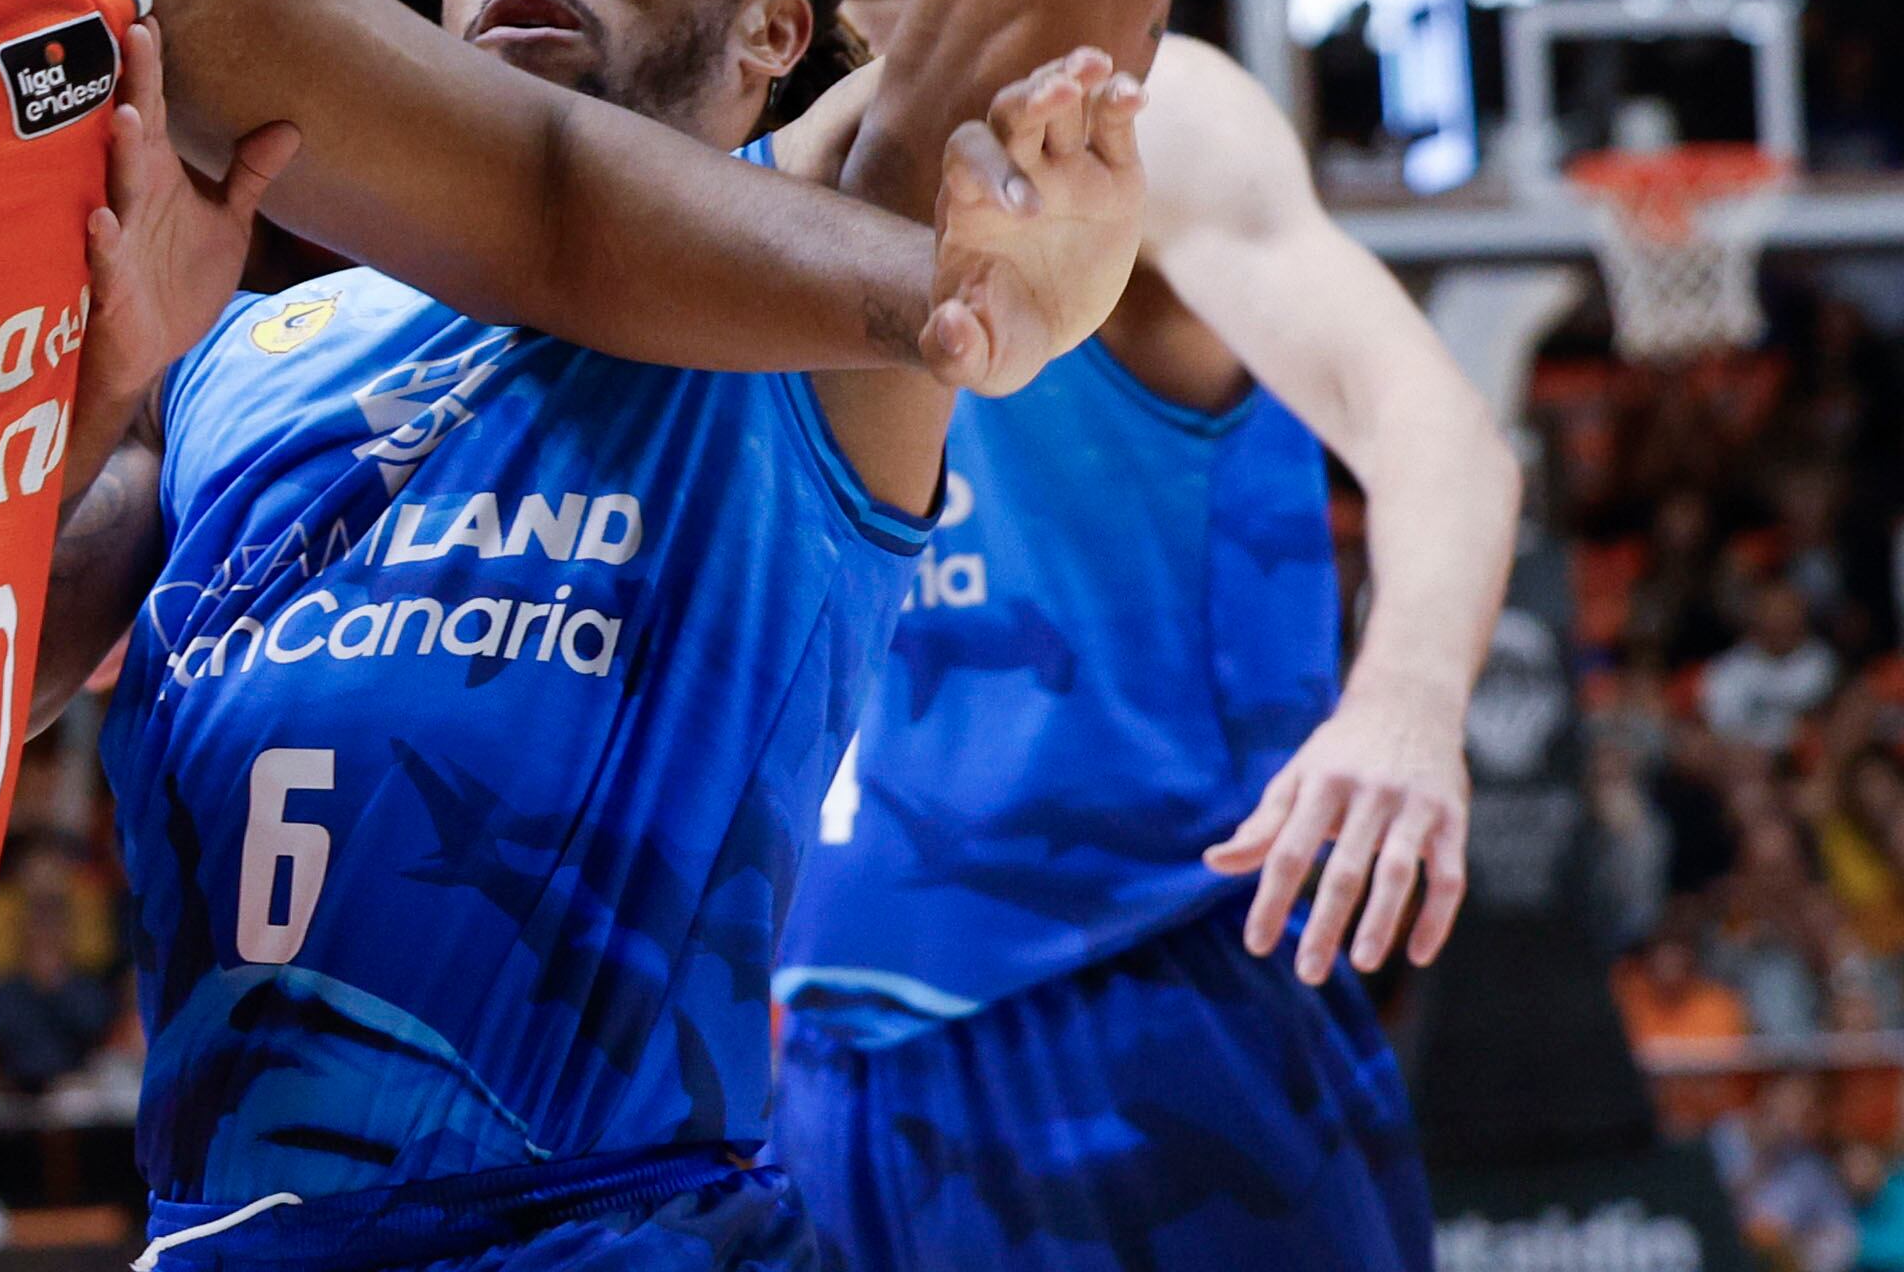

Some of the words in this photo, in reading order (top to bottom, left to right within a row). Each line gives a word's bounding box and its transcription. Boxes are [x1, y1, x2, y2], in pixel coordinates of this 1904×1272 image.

[16, 64, 67, 96] liga
[25, 73, 112, 122] endesa
[235, 746, 336, 965] 6
